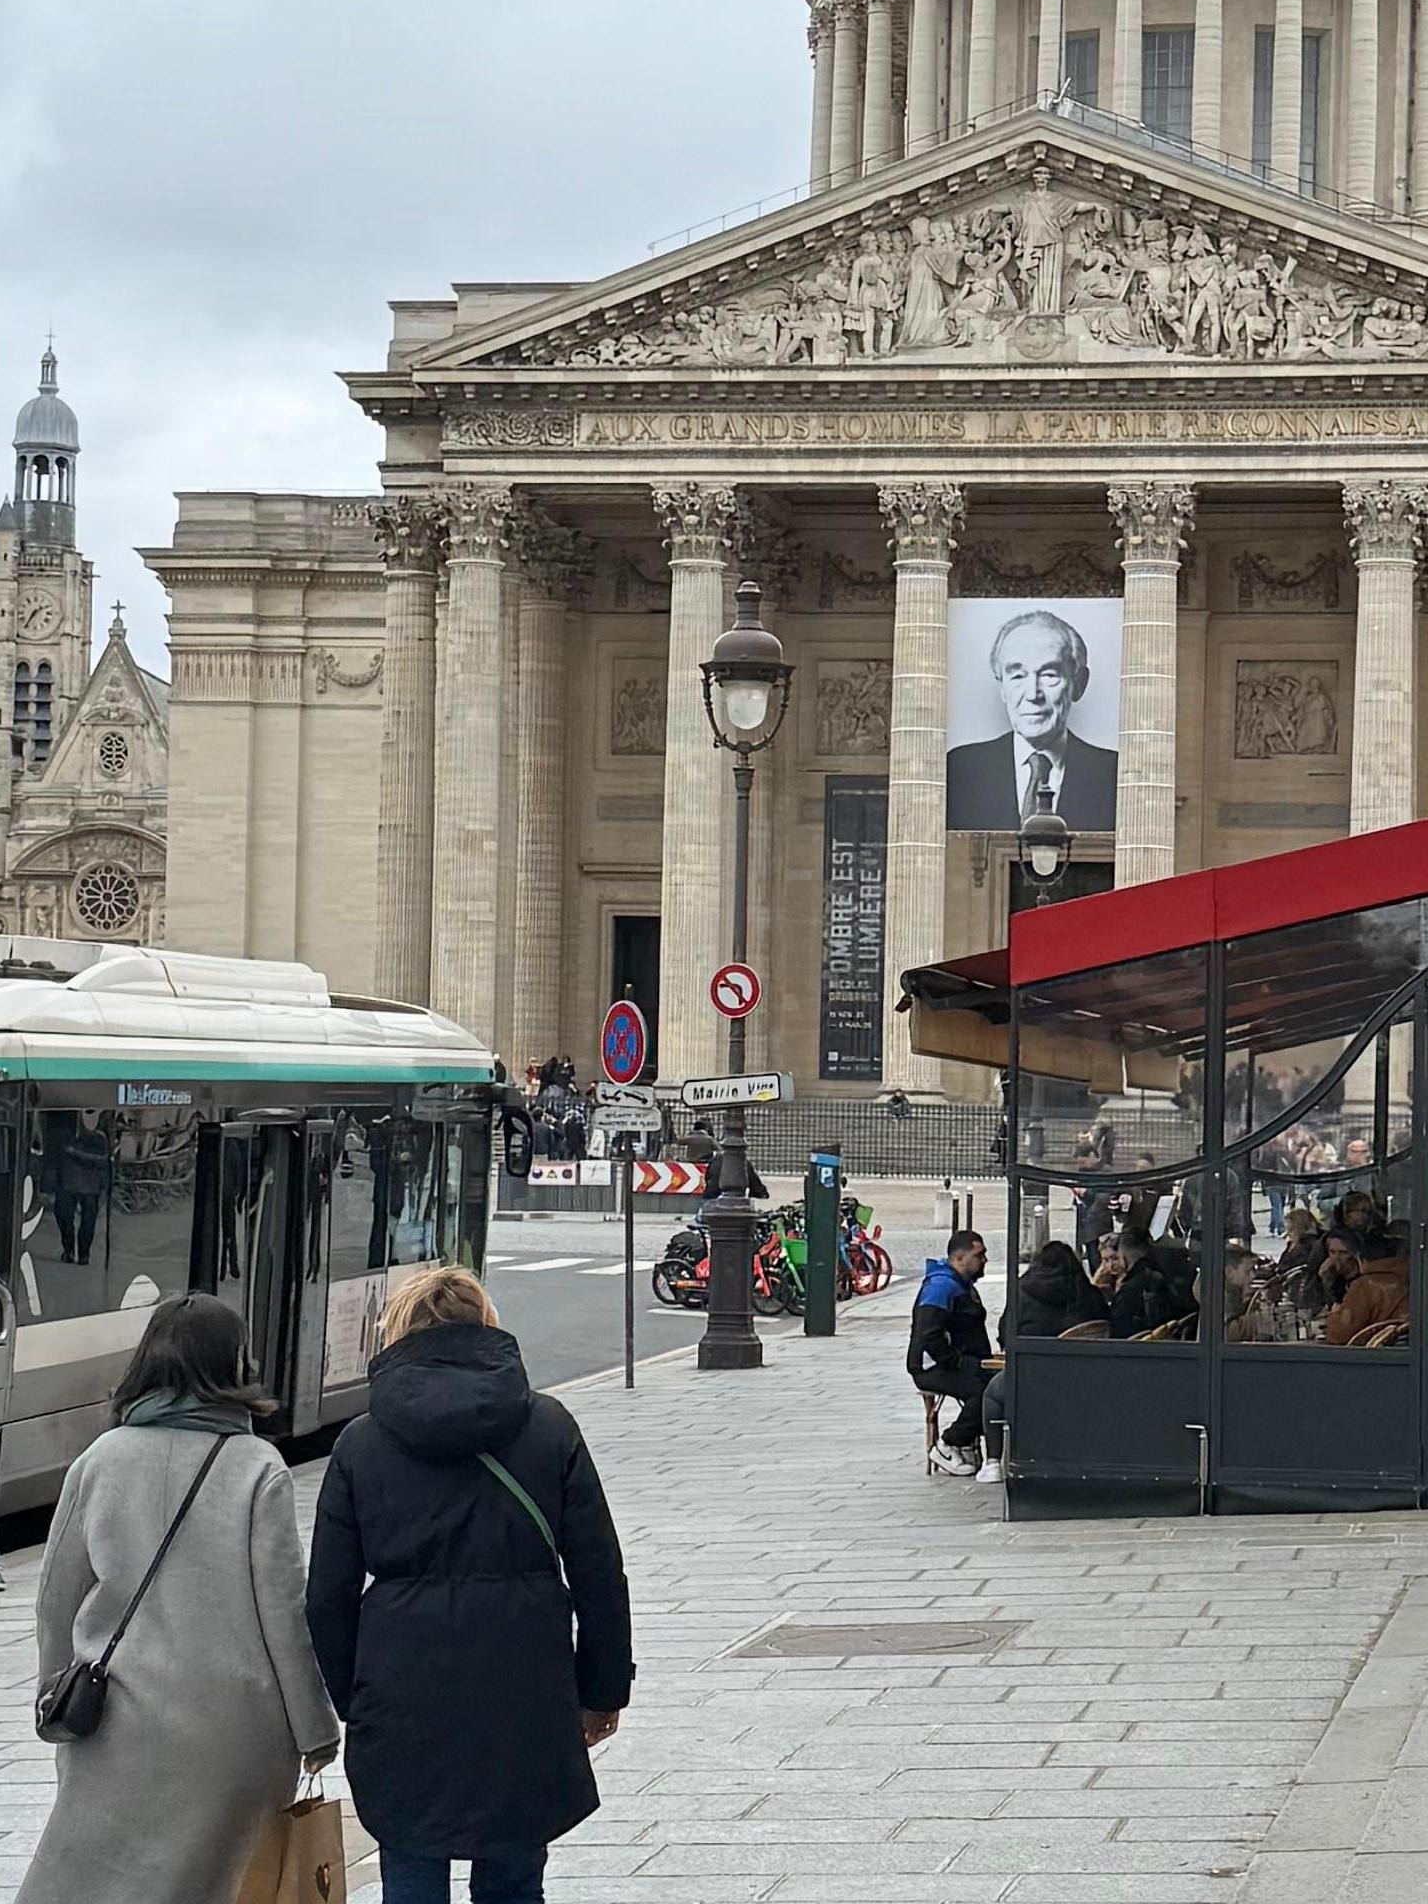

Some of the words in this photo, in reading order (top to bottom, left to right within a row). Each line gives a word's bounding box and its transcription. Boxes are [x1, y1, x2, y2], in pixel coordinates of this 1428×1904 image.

[587, 414, 660, 442] AUX
[669, 414, 810, 442] GRANDS
[817, 413, 966, 441] HOMMES
[985, 413, 1034, 441] LA
[1041, 411, 1169, 440] PATRIE
[831, 838, 854, 881] EST
[829, 892, 854, 973] OMBRE
